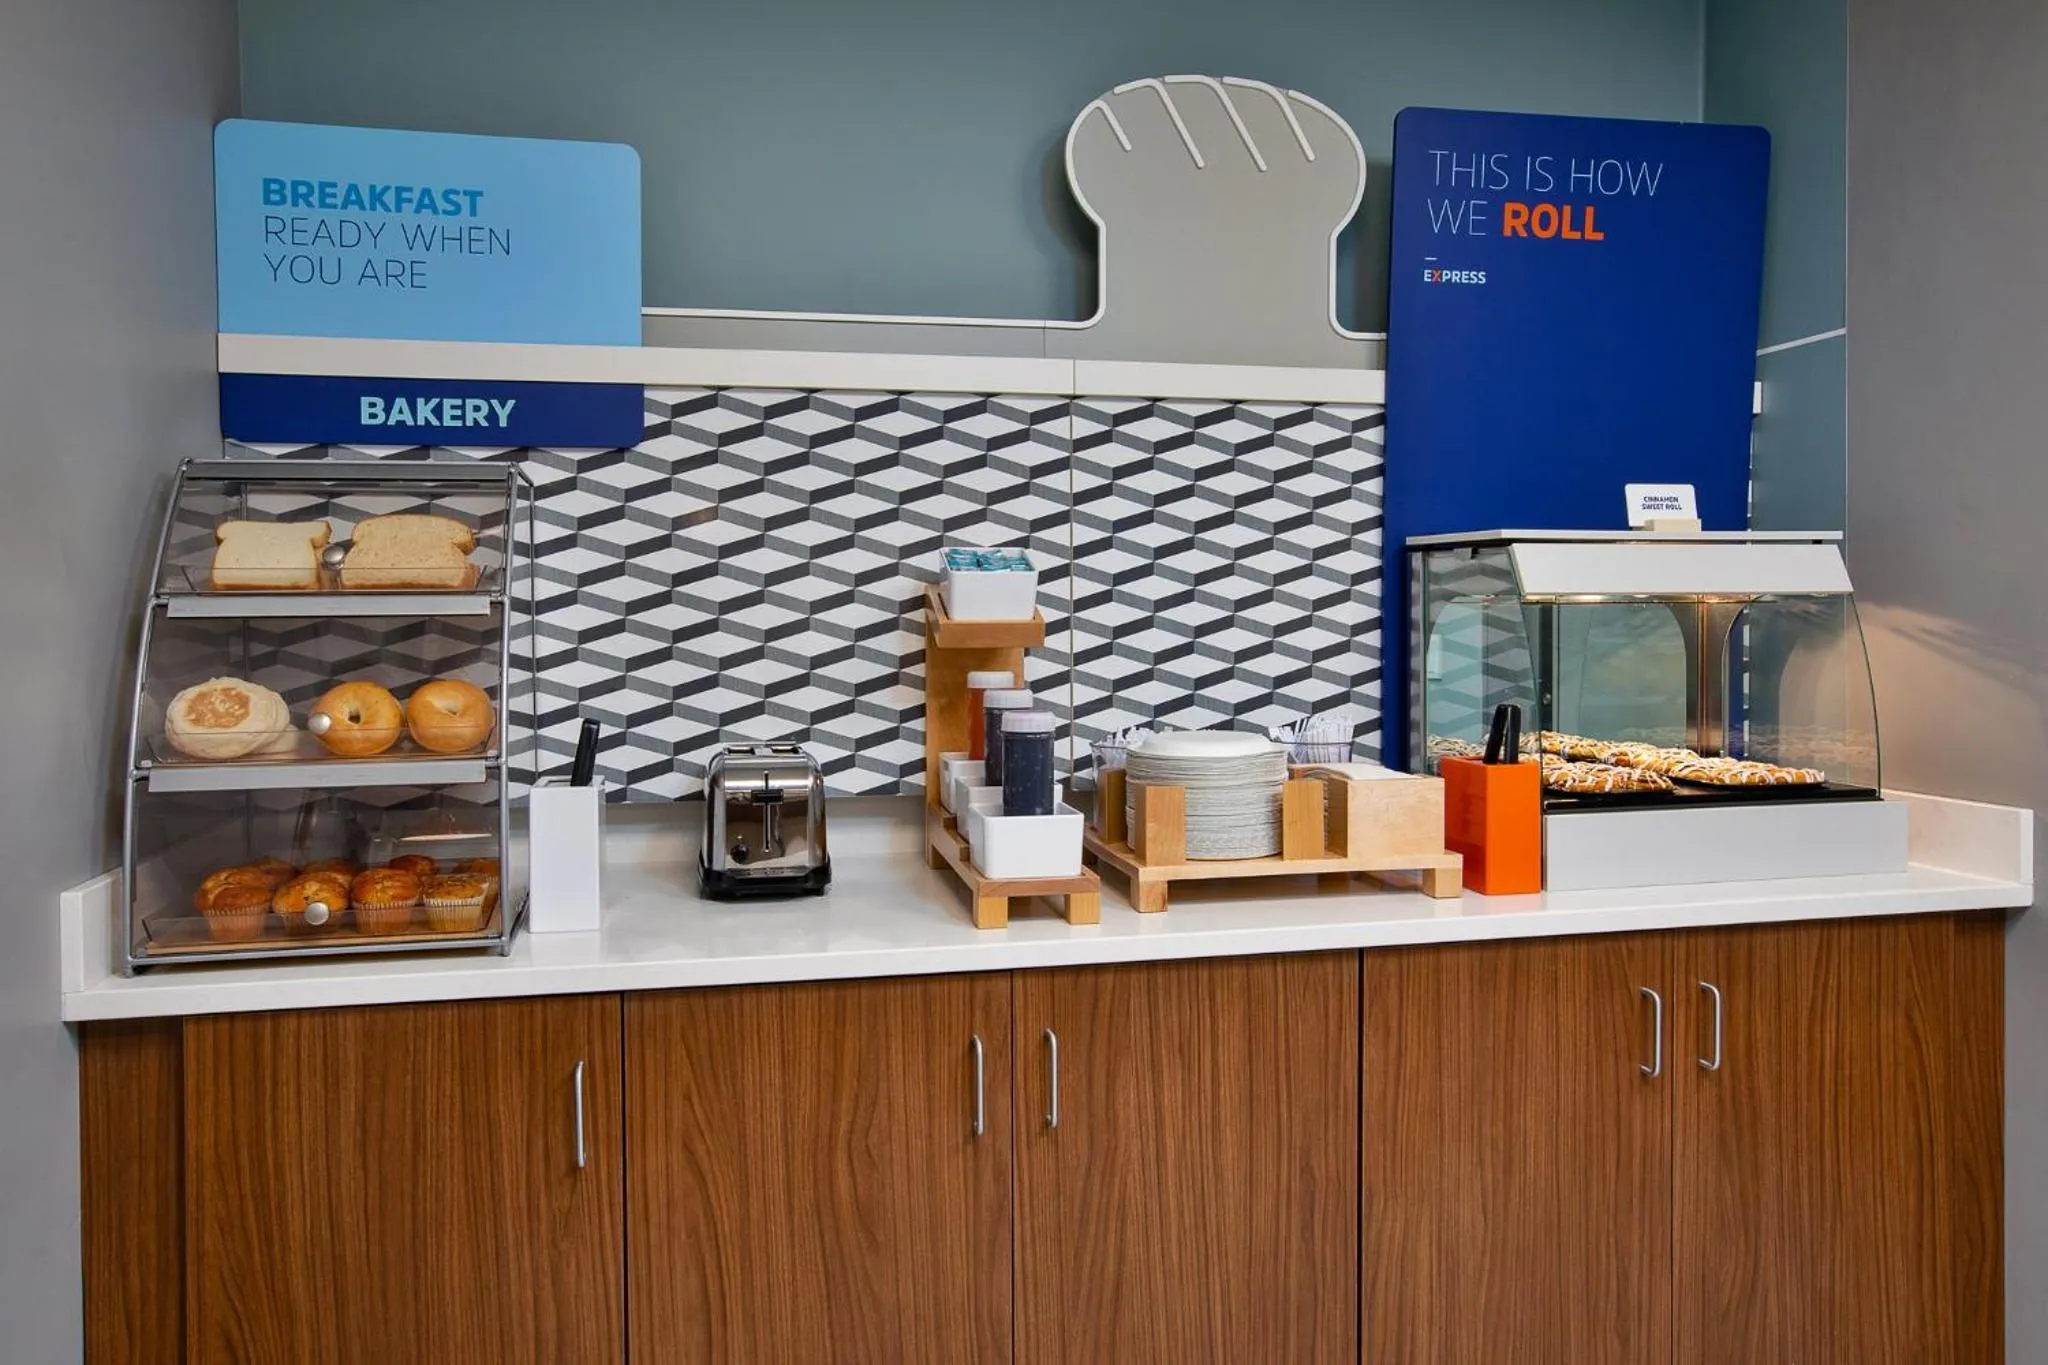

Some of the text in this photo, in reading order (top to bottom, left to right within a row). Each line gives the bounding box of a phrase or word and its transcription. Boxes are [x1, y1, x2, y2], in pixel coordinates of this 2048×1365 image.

[1429, 150, 1663, 197] THIS IS HOW
[262, 177, 484, 217] BREAKFAST
[264, 215, 511, 256] READY WHEN
[1427, 198, 1604, 241] WE ROLL
[263, 253, 428, 289] YOU ARE
[1423, 269, 1487, 285] EXPRESS
[360, 396, 516, 428] BAKERY
